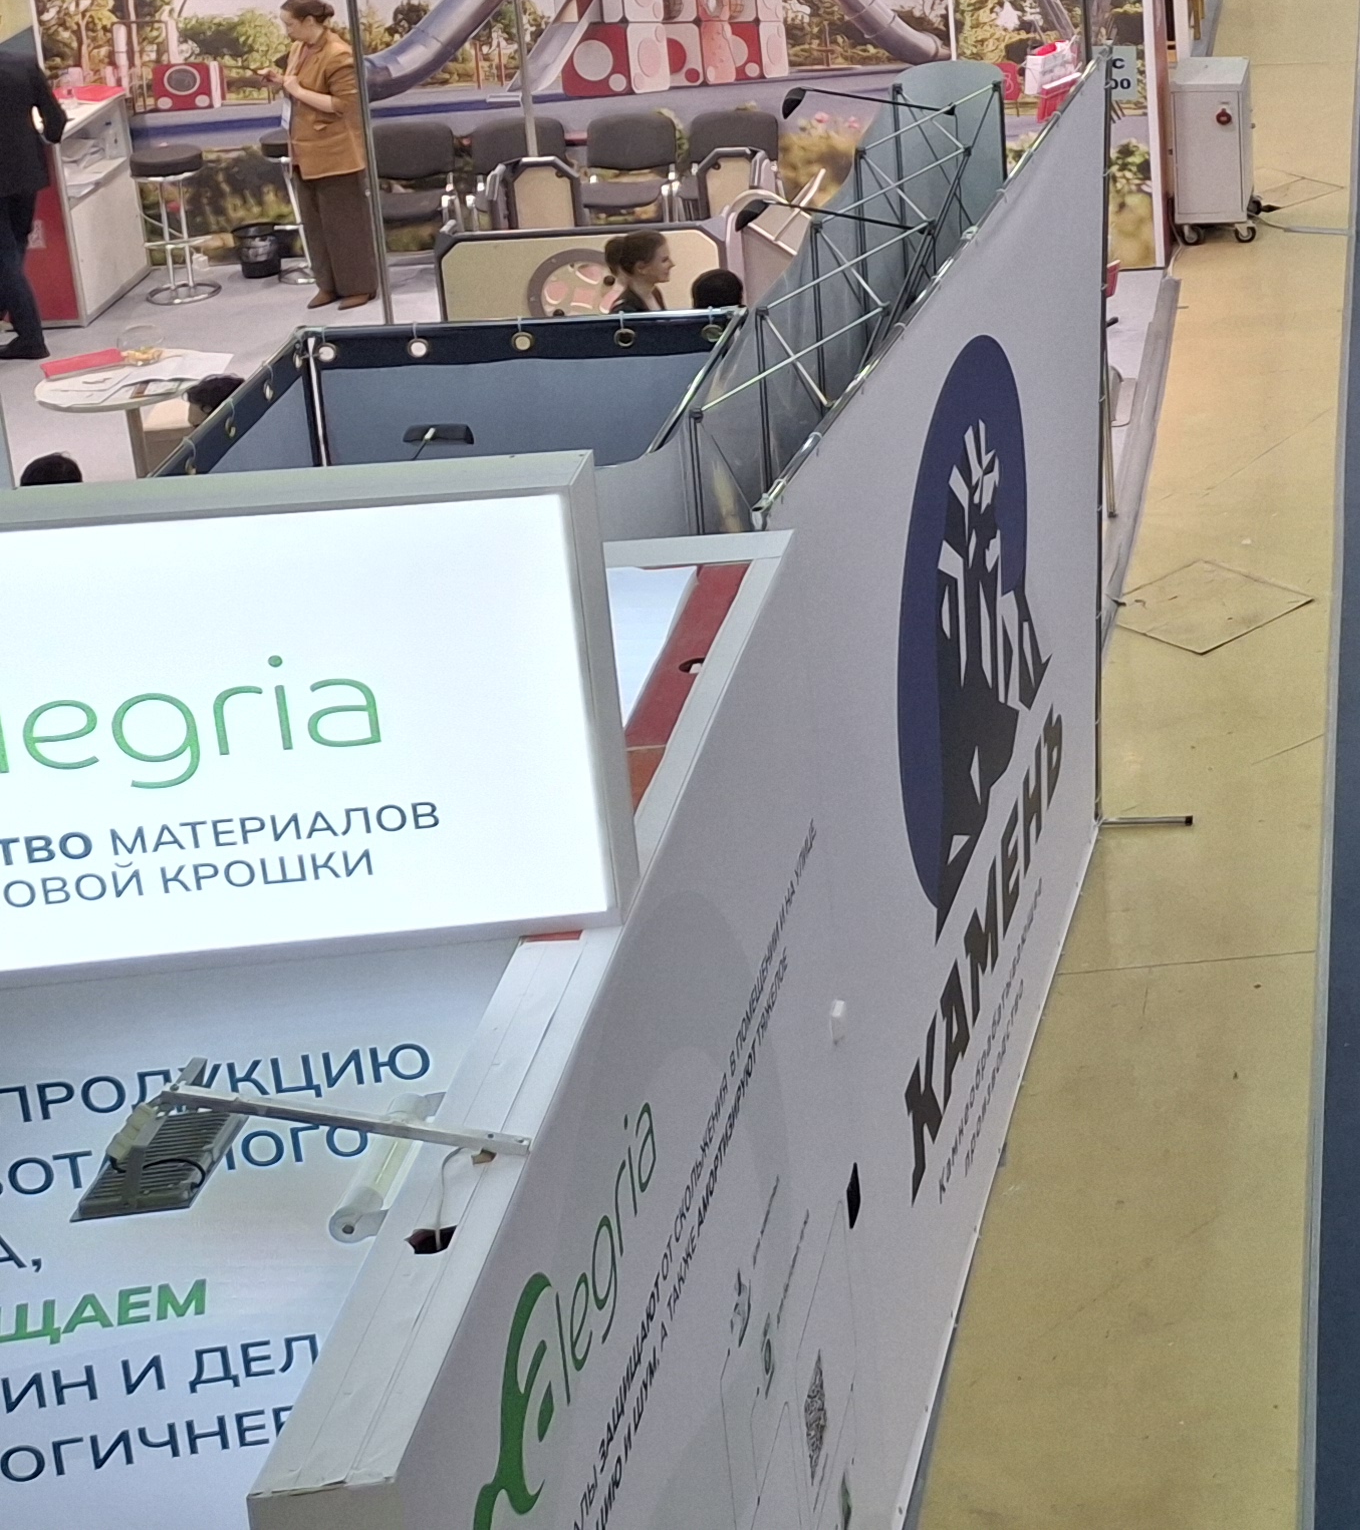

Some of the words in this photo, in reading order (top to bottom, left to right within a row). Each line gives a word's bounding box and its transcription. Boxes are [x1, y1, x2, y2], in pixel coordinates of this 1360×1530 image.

[0, 830, 93, 867] ТВО
[109, 801, 441, 857] МАТЕРИАЛОВ
[3, 860, 144, 908] ОВОЙ
[161, 848, 375, 895] КРОШКИ
[0, 1124, 370, 1196] ОТОГО
[600, 1271, 661, 1474] ЗАЩИЩАЮТ
[661, 1234, 673, 1282] ОТ
[674, 1072, 728, 1244] СКОЛЬЖЕНИЯ
[729, 1049, 736, 1078] В
[624, 1421, 632, 1464] И
[660, 1319, 668, 1352] А
[666, 1225, 696, 1322] ТАКЖЕ
[698, 1038, 757, 1238] АМОРТИЗИРУЮТ
[0, 1278, 207, 1345] ЩАЕМ
[2, 1365, 98, 1414] ИН
[121, 1354, 166, 1396] И
